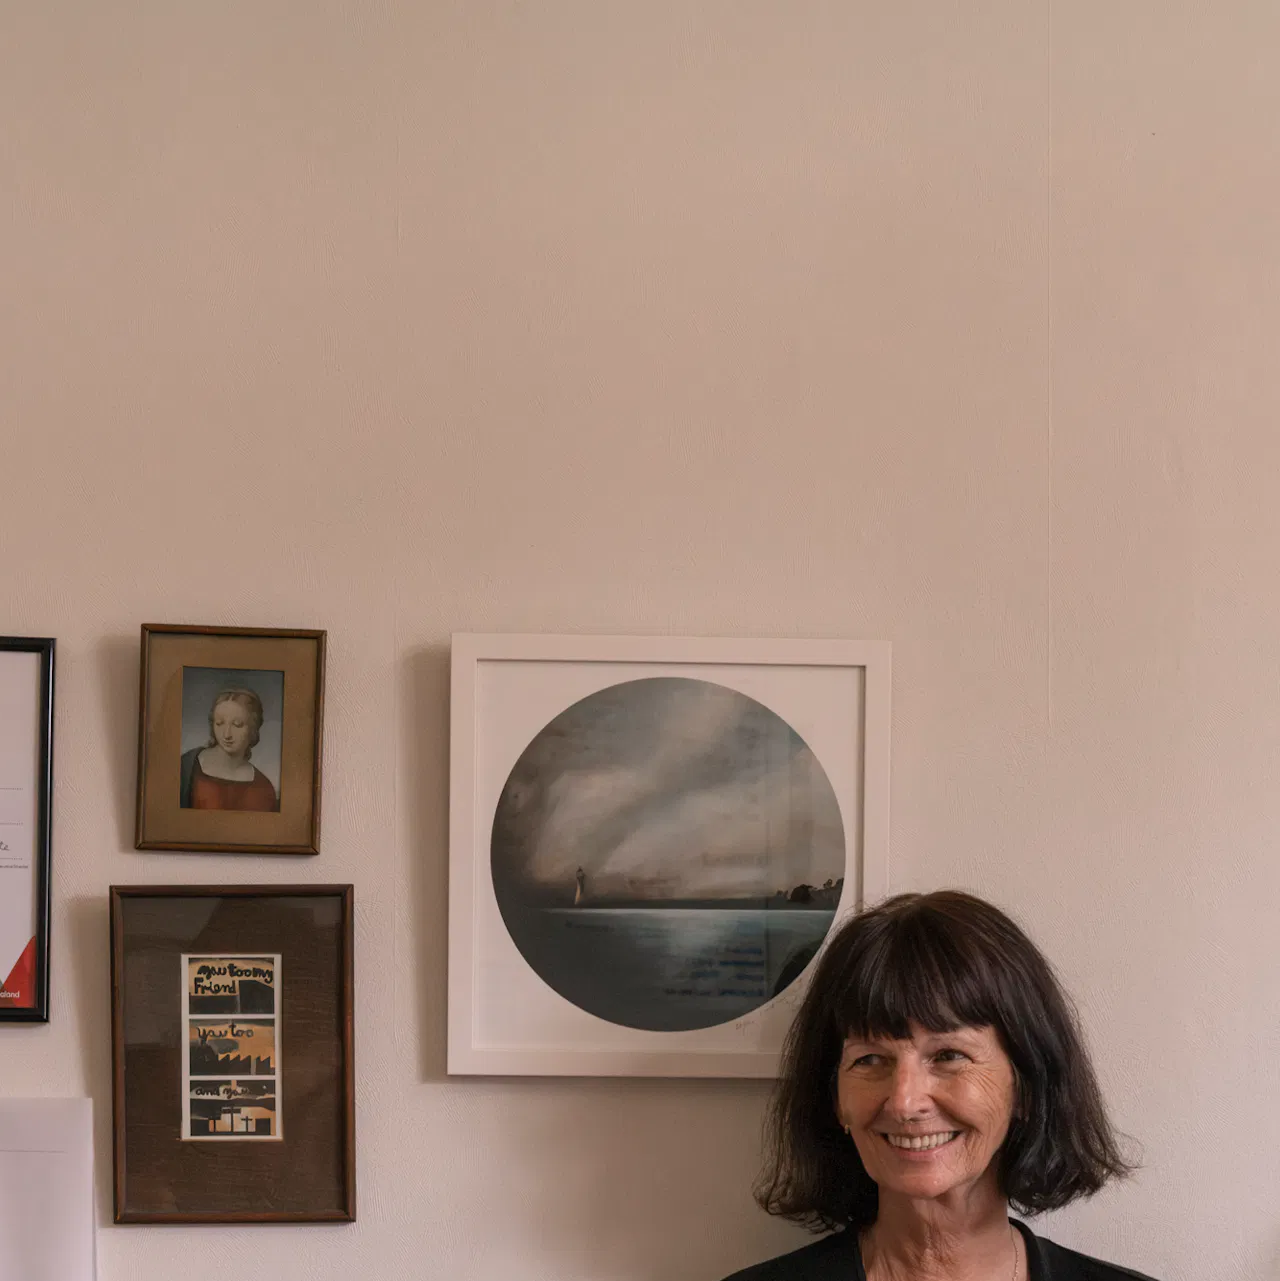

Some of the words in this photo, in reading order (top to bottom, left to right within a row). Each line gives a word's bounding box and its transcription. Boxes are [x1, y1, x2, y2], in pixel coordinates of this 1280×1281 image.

[228, 963, 252, 977] too
[253, 967, 274, 983] my
[194, 977, 237, 995] Friend
[229, 1022, 254, 1038] too
[195, 1087, 220, 1097] and
